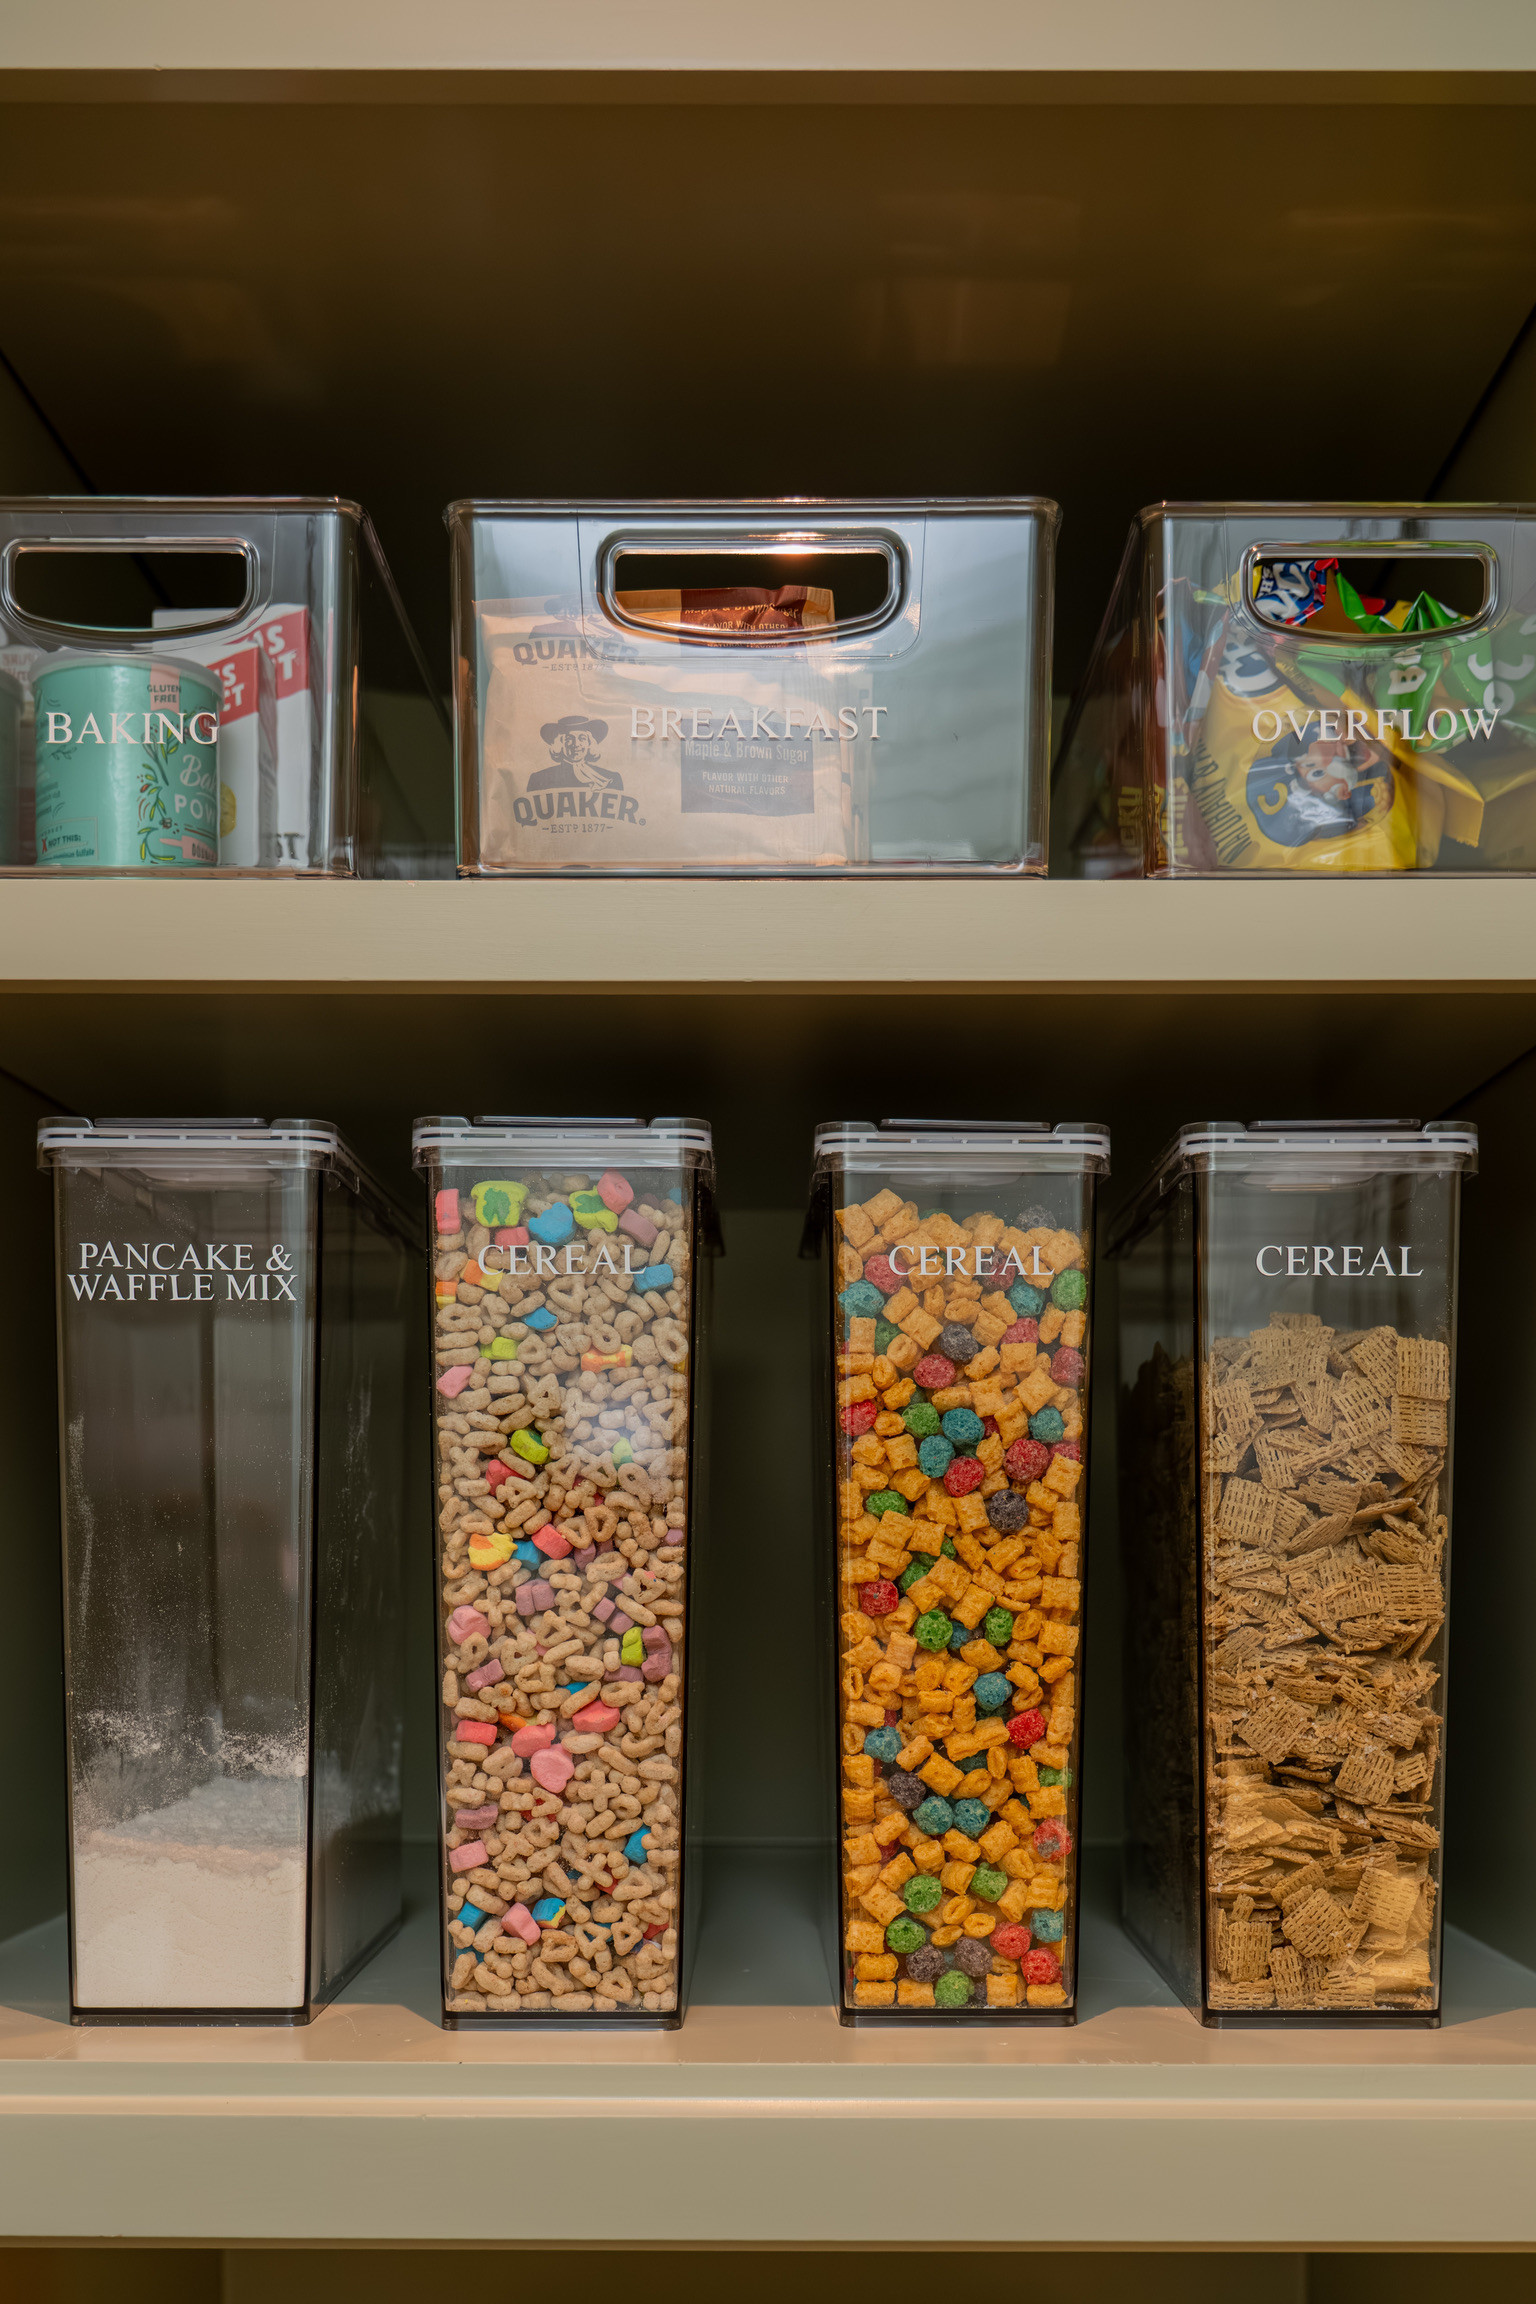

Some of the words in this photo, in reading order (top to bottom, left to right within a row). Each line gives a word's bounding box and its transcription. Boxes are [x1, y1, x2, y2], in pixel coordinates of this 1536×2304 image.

[146, 684, 182, 693] GLUTEN
[153, 694, 177, 703] FREE
[45, 712, 219, 745] BAKING
[630, 706, 888, 741] BREAKFAST
[1252, 708, 1501, 741] OVERFLOW
[685, 740, 719, 760] Maple
[723, 741, 732, 757] &
[736, 742, 772, 759] Brown
[776, 745, 809, 764] Sugar
[702, 771, 733, 782] FLAVOR
[737, 772, 758, 782] WITH
[708, 784, 746, 794] NATURAL
[749, 785, 786, 796] FLAVORS
[512, 791, 640, 828] QUAKER
[582, 824, 606, 833] 1877
[79, 1241, 255, 1271] PANCAKE
[265, 1244, 295, 1271] &
[477, 1244, 647, 1276] CEREAL
[888, 1245, 1056, 1277] CEREAL
[1256, 1245, 1424, 1277] CEREAL
[67, 1273, 215, 1301] WAFFLE
[226, 1273, 298, 1301] MIX
